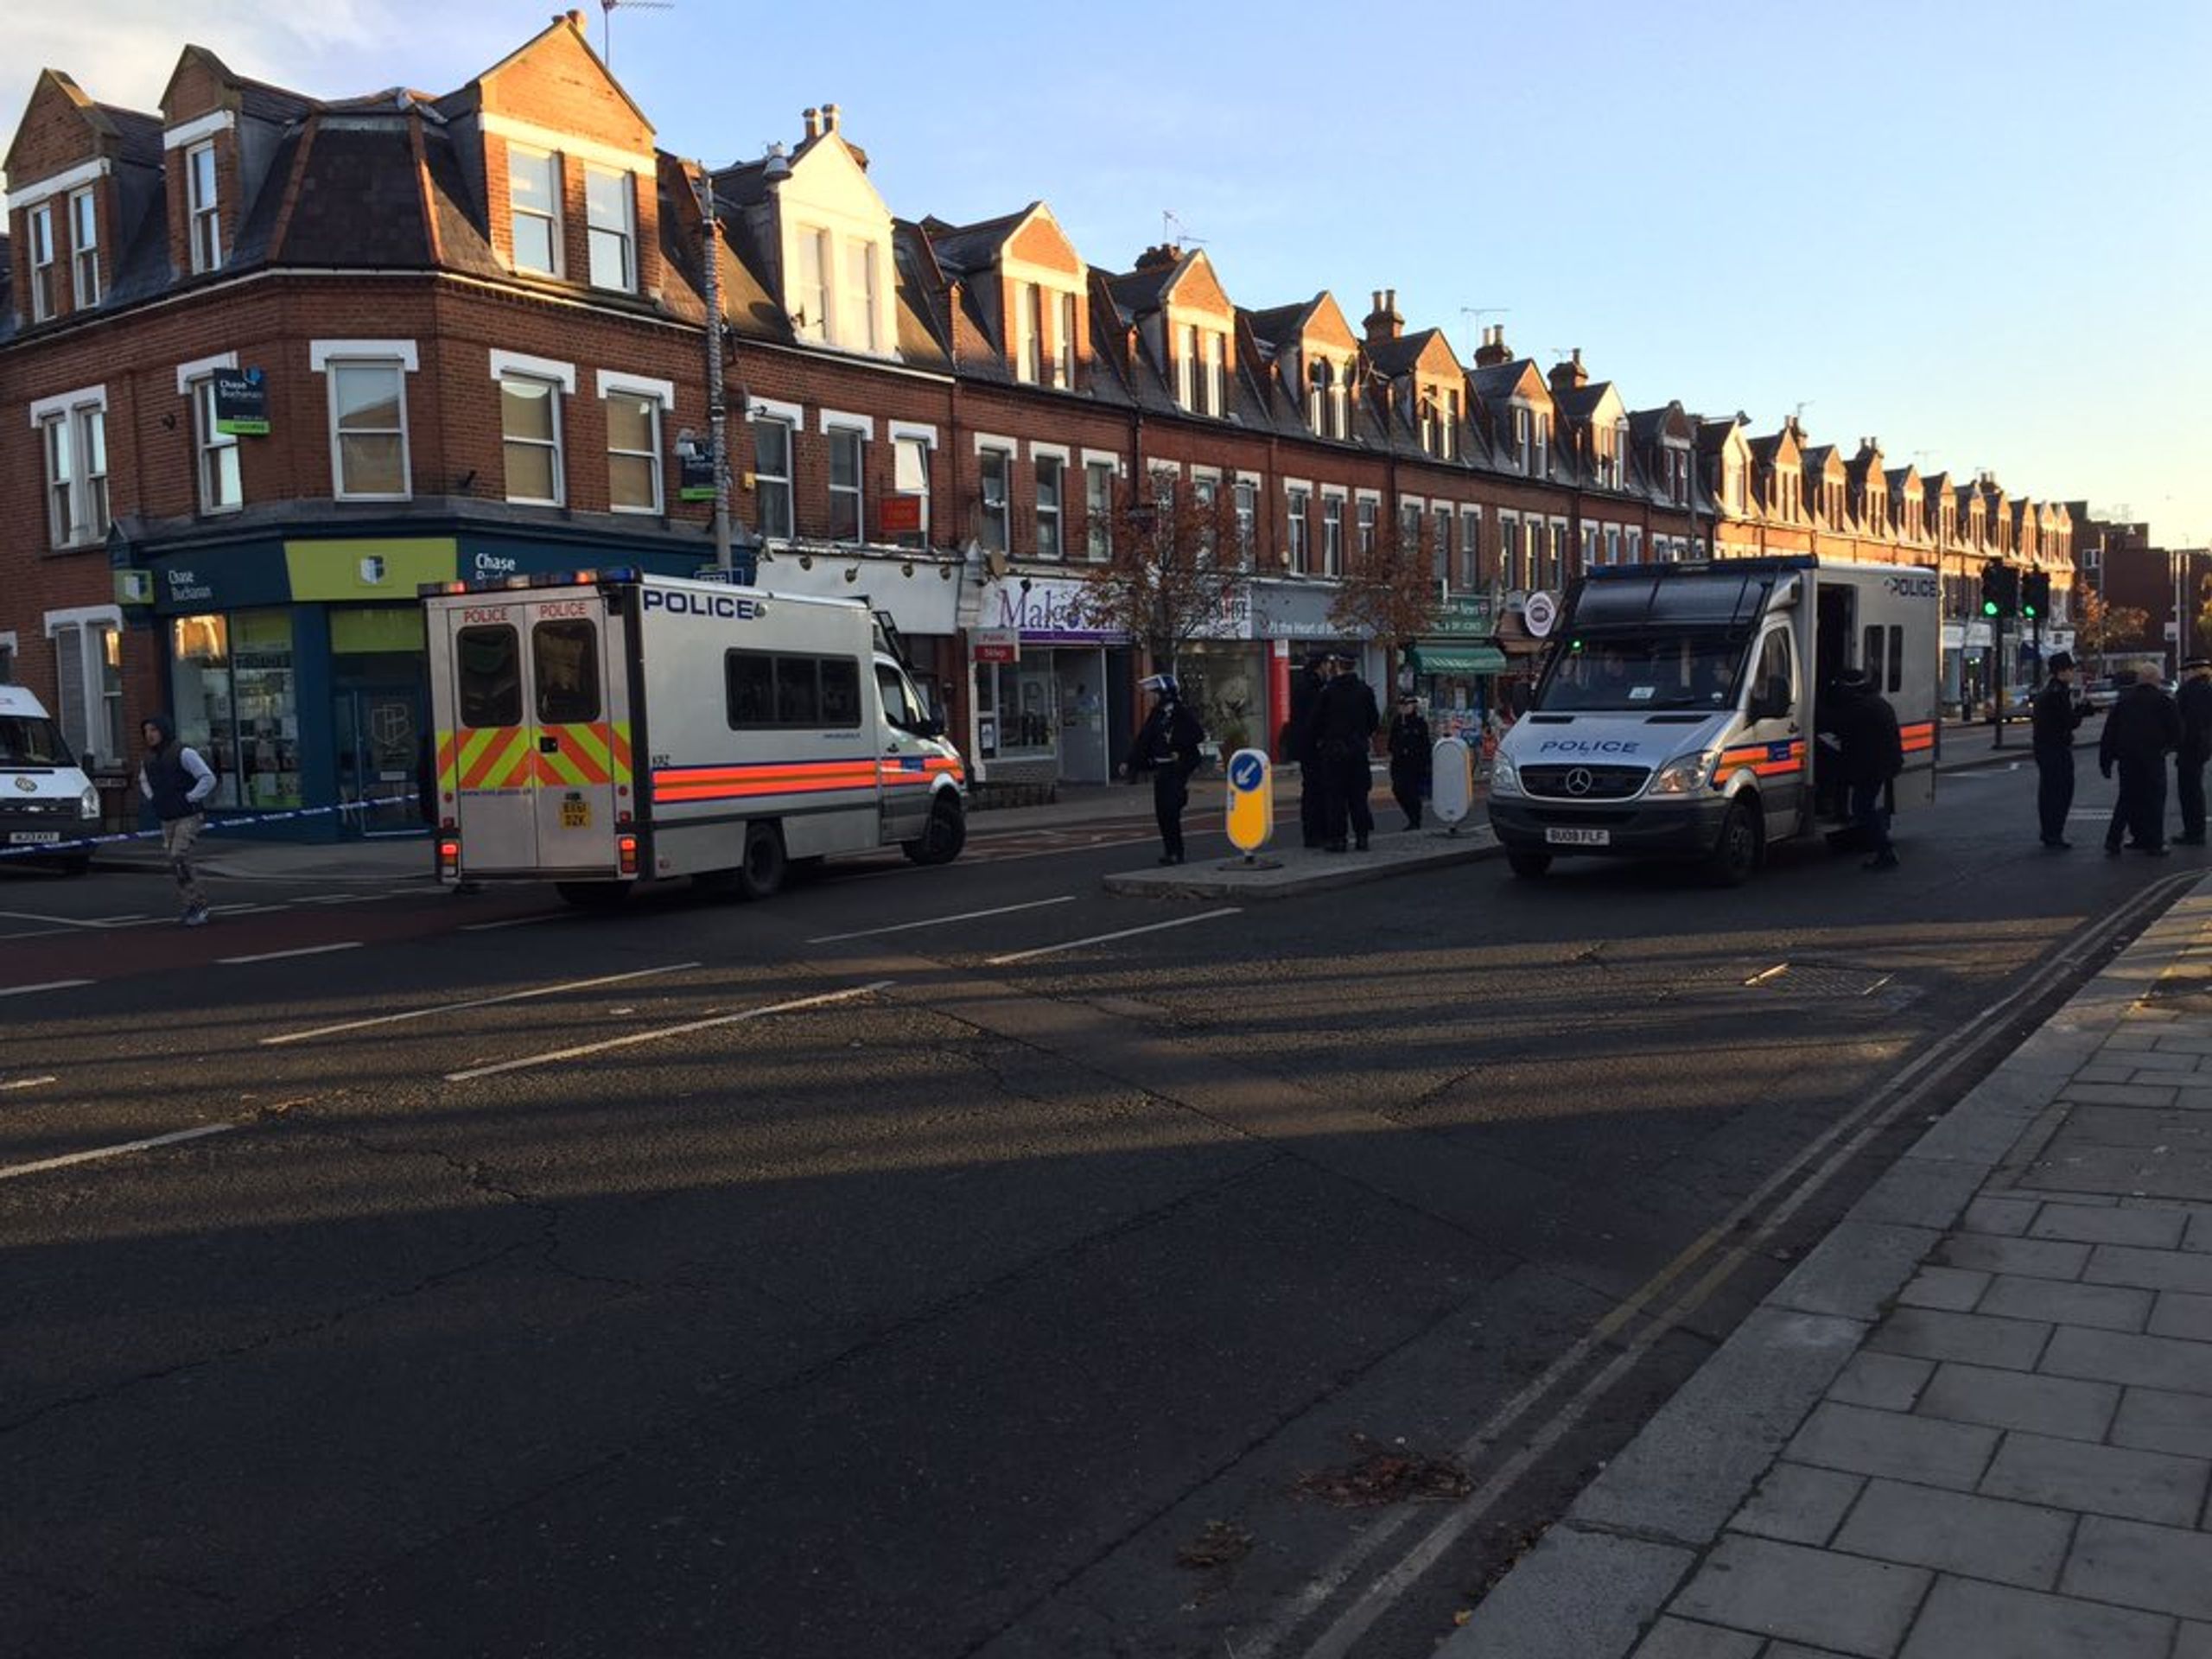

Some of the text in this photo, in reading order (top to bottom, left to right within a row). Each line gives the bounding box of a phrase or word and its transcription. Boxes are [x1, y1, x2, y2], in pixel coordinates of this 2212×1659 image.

[474, 553, 516, 571] Chase
[1889, 577, 1936, 598] POLICE
[539, 602, 587, 618] POLICE
[642, 589, 753, 620] POLICE
[463, 607, 508, 622] POLICE
[1540, 741, 1641, 753] POLICE
